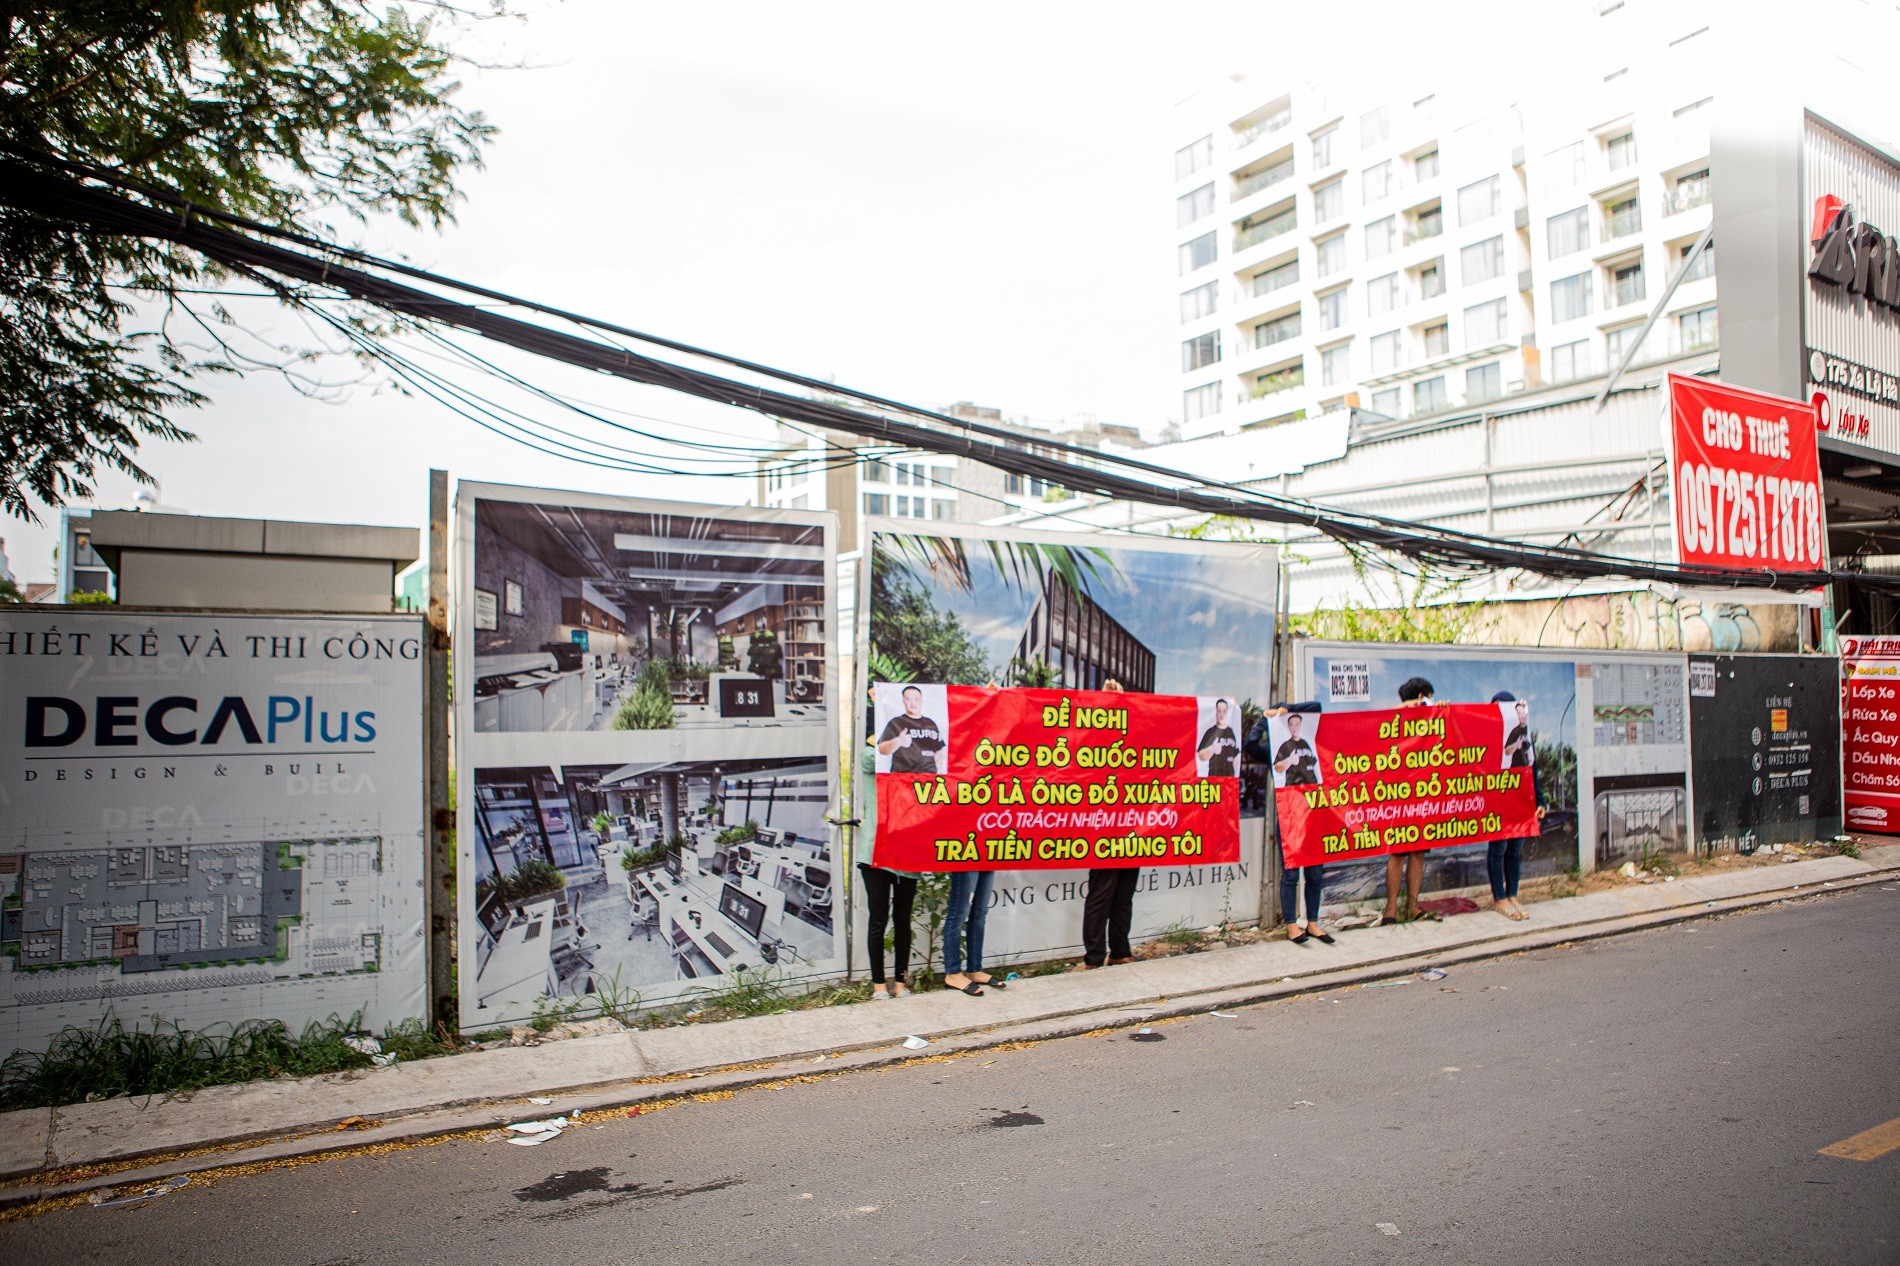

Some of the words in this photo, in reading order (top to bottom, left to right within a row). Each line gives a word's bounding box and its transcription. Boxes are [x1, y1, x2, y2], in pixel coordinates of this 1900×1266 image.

[1826, 358, 1848, 386] 175
[1849, 364, 1865, 391] Xa
[1882, 375, 1898, 401] Hà
[1702, 407, 1743, 451] CHO
[1746, 416, 1791, 460] THUÊ
[1838, 406, 1855, 433] Lốp
[1857, 414, 1870, 436] Xe
[1680, 461, 1820, 565] 0972517878
[109, 627, 159, 656] KẾ
[178, 629, 229, 658] VÀ
[246, 636, 307, 660] THI
[323, 632, 420, 660] CÔNG
[1852, 684, 1876, 700] Lốp
[1878, 686, 1896, 699] Xe
[1042, 696, 1070, 728] ĐỀ
[1075, 706, 1128, 735] NGHỊ
[1404, 718, 1446, 740] NGHỊ
[1880, 708, 1897, 721] Xe
[975, 737, 1030, 767] ÔNG
[1035, 736, 1071, 768] ĐỖ
[1076, 739, 1137, 768] QUỐC
[1141, 748, 1179, 769] HUY
[1871, 731, 1899, 747] Quy
[25, 766, 177, 782] DESIGN
[214, 764, 228, 777] &
[1334, 752, 1371, 775] ÔNG
[1375, 745, 1401, 771] ĐỖ
[1406, 743, 1455, 768] QUỐC
[1458, 746, 1488, 764] HUY
[913, 776, 951, 804] VÀ
[957, 774, 992, 805] BỐ
[998, 776, 1026, 804] LÀ
[1031, 777, 1083, 805] ÔNG
[1088, 774, 1119, 805] ĐỖ
[1123, 778, 1176, 804] XUÂN
[1180, 778, 1221, 809] DIỆN
[1304, 785, 1329, 809] VÀ
[1329, 781, 1349, 807] BỐ
[1352, 782, 1370, 804] LÀ
[1373, 780, 1411, 801] ÔNG
[1415, 772, 1441, 797] ĐỖ
[1446, 773, 1483, 795] XUÂN
[1487, 770, 1521, 793] DIỆN
[1771, 778, 1791, 790] DECA
[1791, 774, 1809, 788] PLUS
[977, 809, 1013, 831] (CÓ
[1015, 809, 1067, 828] TRÁCH
[1070, 808, 1115, 830] NHIỆM
[1117, 808, 1145, 827] LIÊN
[1147, 808, 1178, 829] ĐỚI)
[1345, 806, 1364, 827] (CÓ
[1366, 804, 1401, 821] TRÁCH
[1403, 800, 1440, 818] NHIỆM
[1441, 798, 1463, 814] LIÊN
[935, 832, 979, 861] TRẢ
[985, 829, 1033, 860] TIỀN
[1038, 838, 1089, 859] CHO
[1094, 831, 1167, 858] CHÚNG
[1171, 830, 1202, 856] TÔI
[1322, 828, 1349, 854] TRẢ
[1353, 823, 1380, 850] TIỀN
[1384, 825, 1419, 846] CHO
[1423, 817, 1478, 841] CHÚNG
[1481, 812, 1502, 833] TÔI
[1738, 829, 1756, 851] HẾT
[1168, 864, 1204, 889] DÀI
